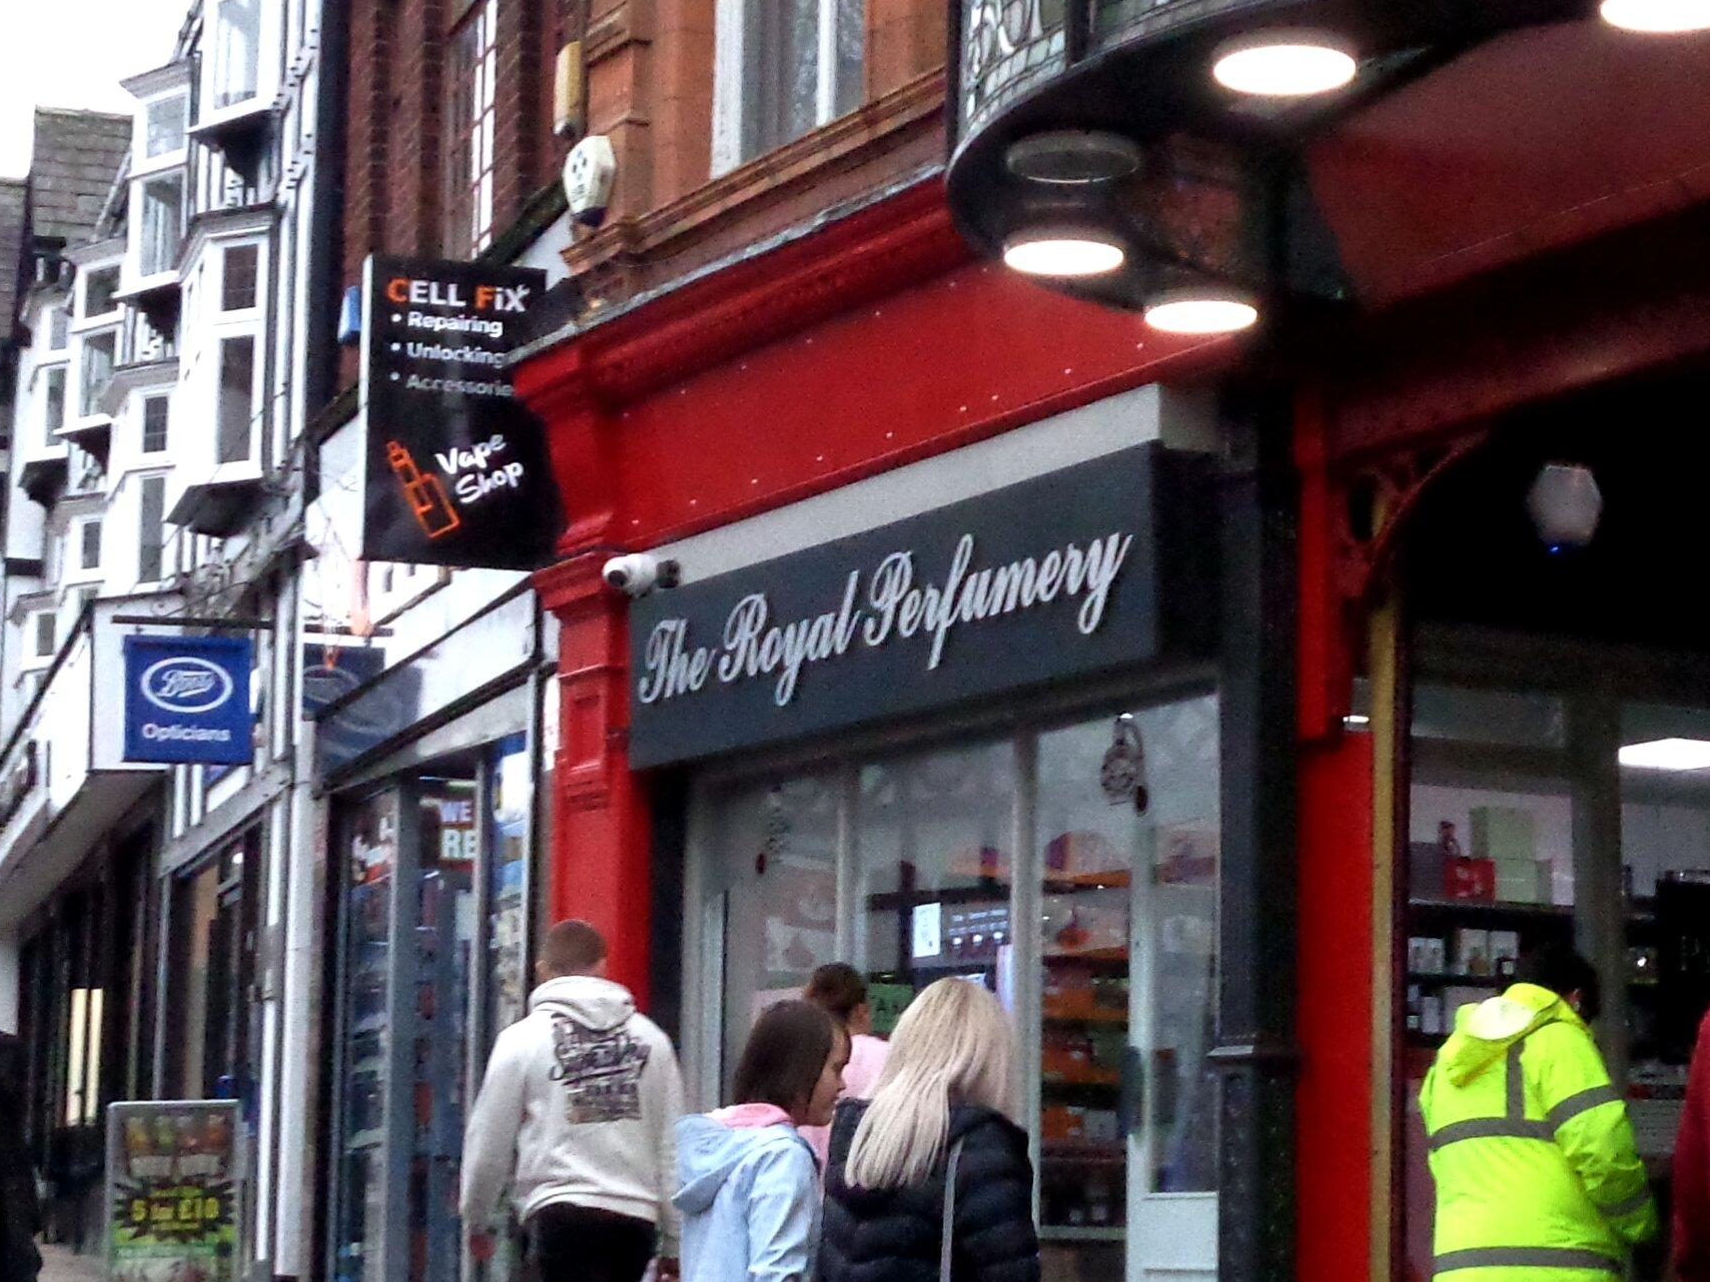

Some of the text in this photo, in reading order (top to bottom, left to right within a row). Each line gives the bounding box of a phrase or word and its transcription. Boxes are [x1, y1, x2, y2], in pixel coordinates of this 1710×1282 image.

[387, 277, 467, 308] CELL
[407, 310, 504, 339] Repairing
[406, 341, 507, 369] Unlocking
[405, 373, 515, 398] Accessorie
[435, 433, 507, 475] Vape
[455, 461, 525, 505] Shop
[638, 531, 1135, 708] The Royal Perfumery
[142, 722, 231, 742] Opticians
